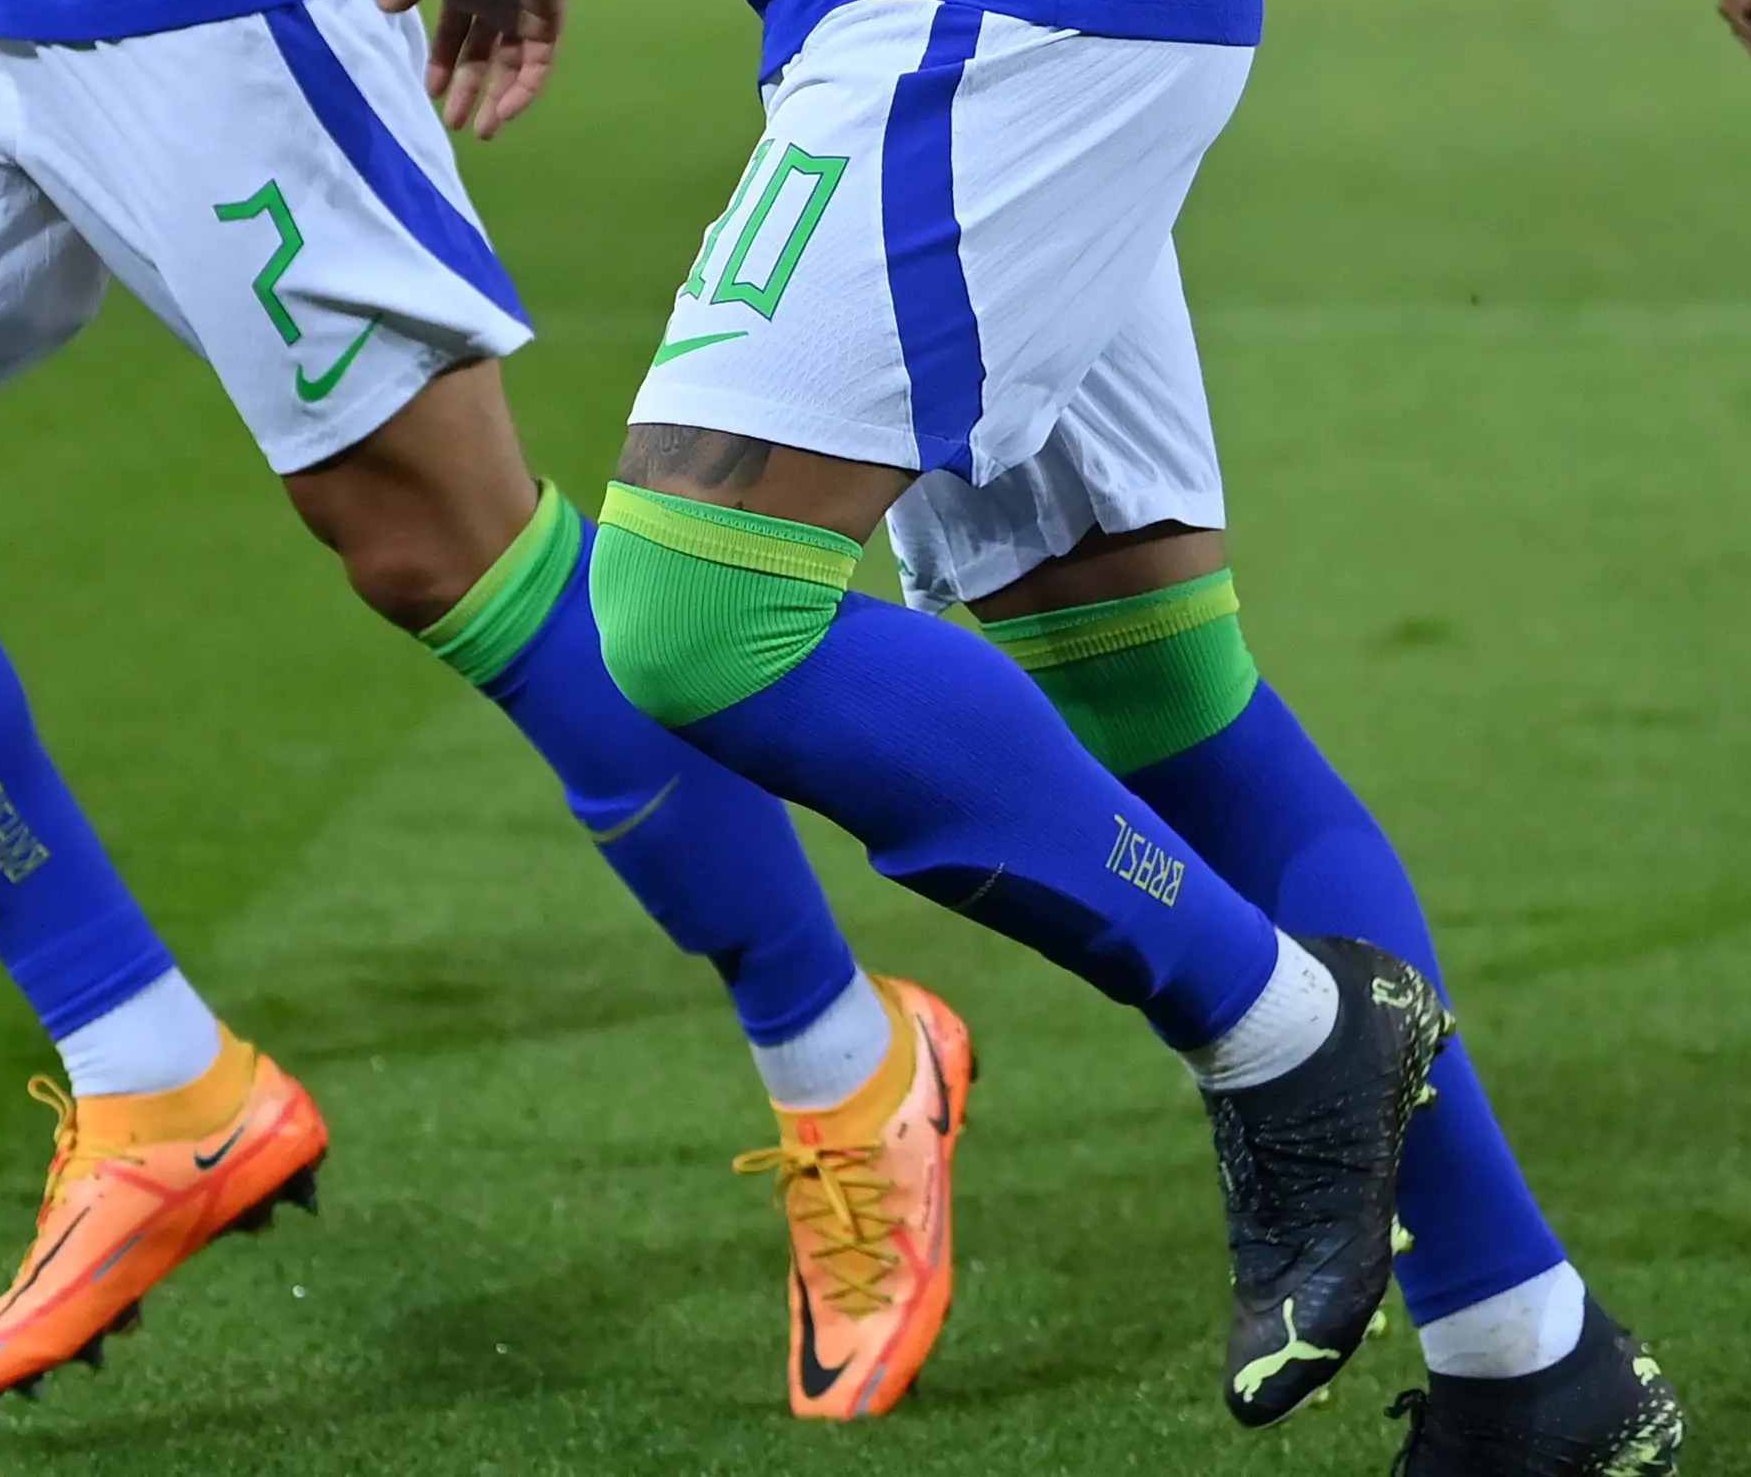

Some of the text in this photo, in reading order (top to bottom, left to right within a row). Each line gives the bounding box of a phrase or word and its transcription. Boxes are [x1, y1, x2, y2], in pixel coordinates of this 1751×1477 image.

[213, 177, 304, 347] 7
[678, 137, 850, 322] 10
[1105, 813, 1185, 908] BRASIL
